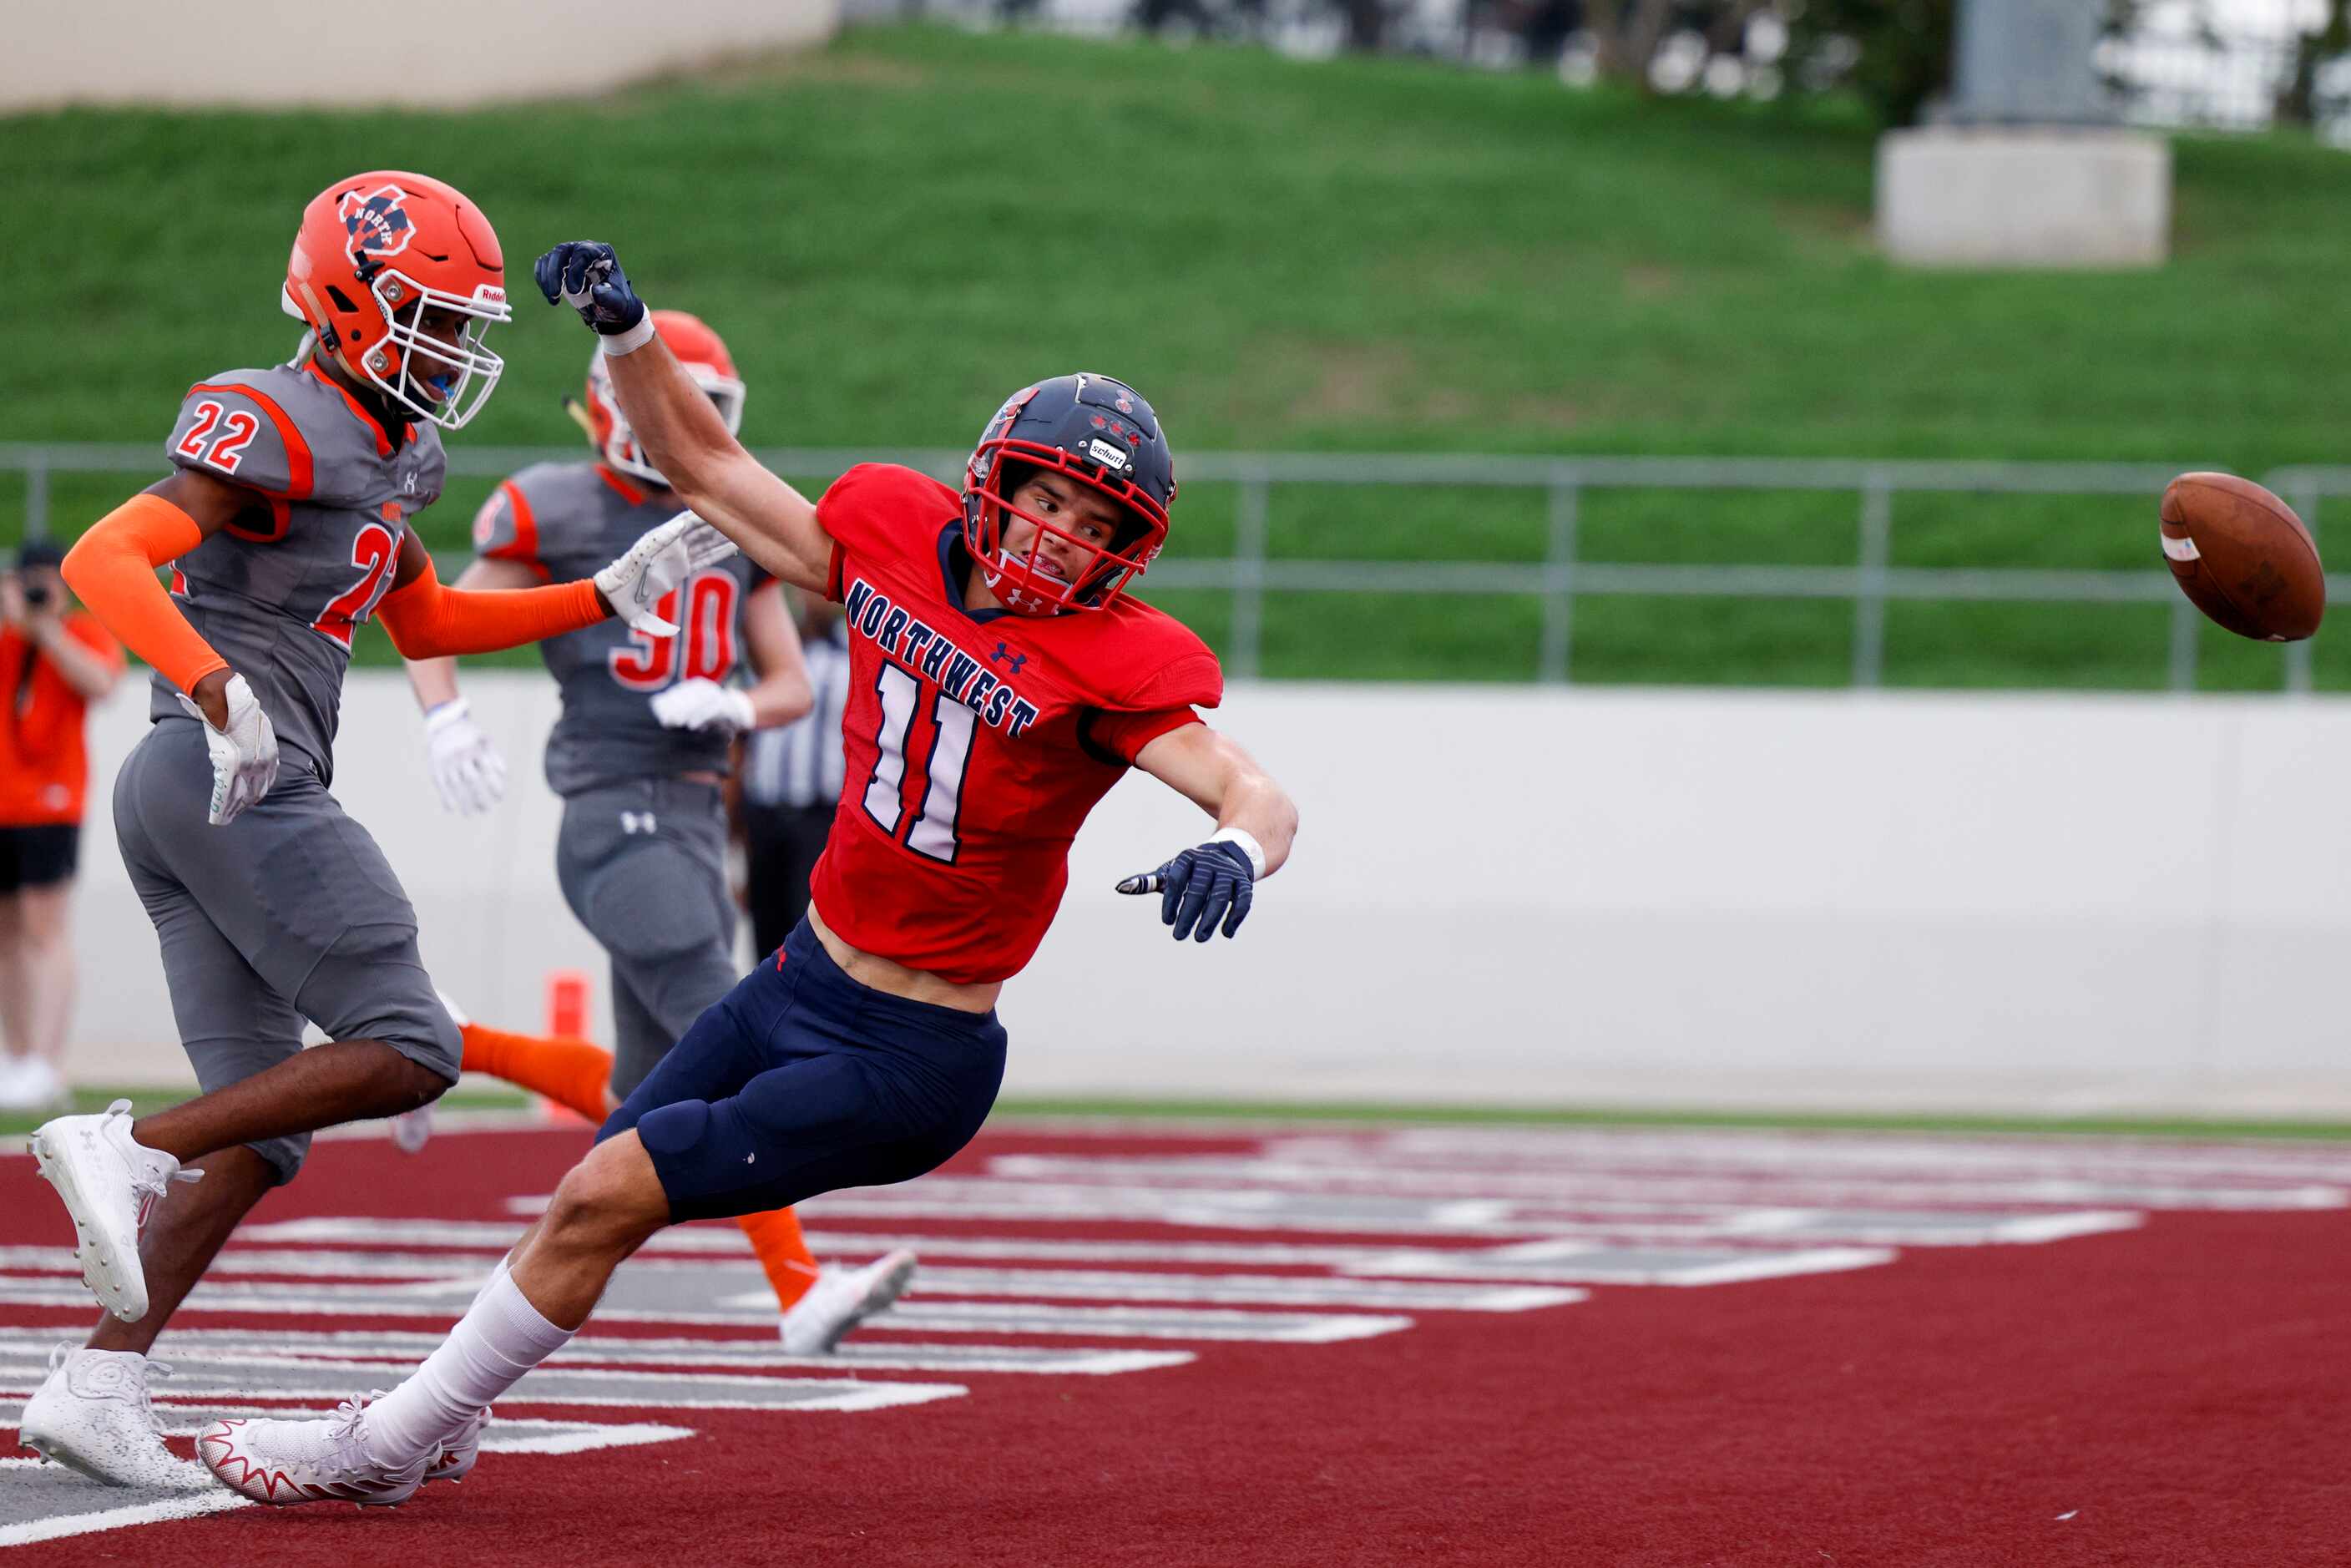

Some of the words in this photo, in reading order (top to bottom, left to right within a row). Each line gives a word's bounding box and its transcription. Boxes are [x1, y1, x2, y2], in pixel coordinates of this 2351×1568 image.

[354, 206, 393, 246] NORTH
[175, 401, 260, 475] 22
[1091, 445, 1124, 465] schutt
[310, 523, 405, 649] 2
[846, 578, 1039, 739] NORTHWEST
[861, 658, 980, 867] 11
